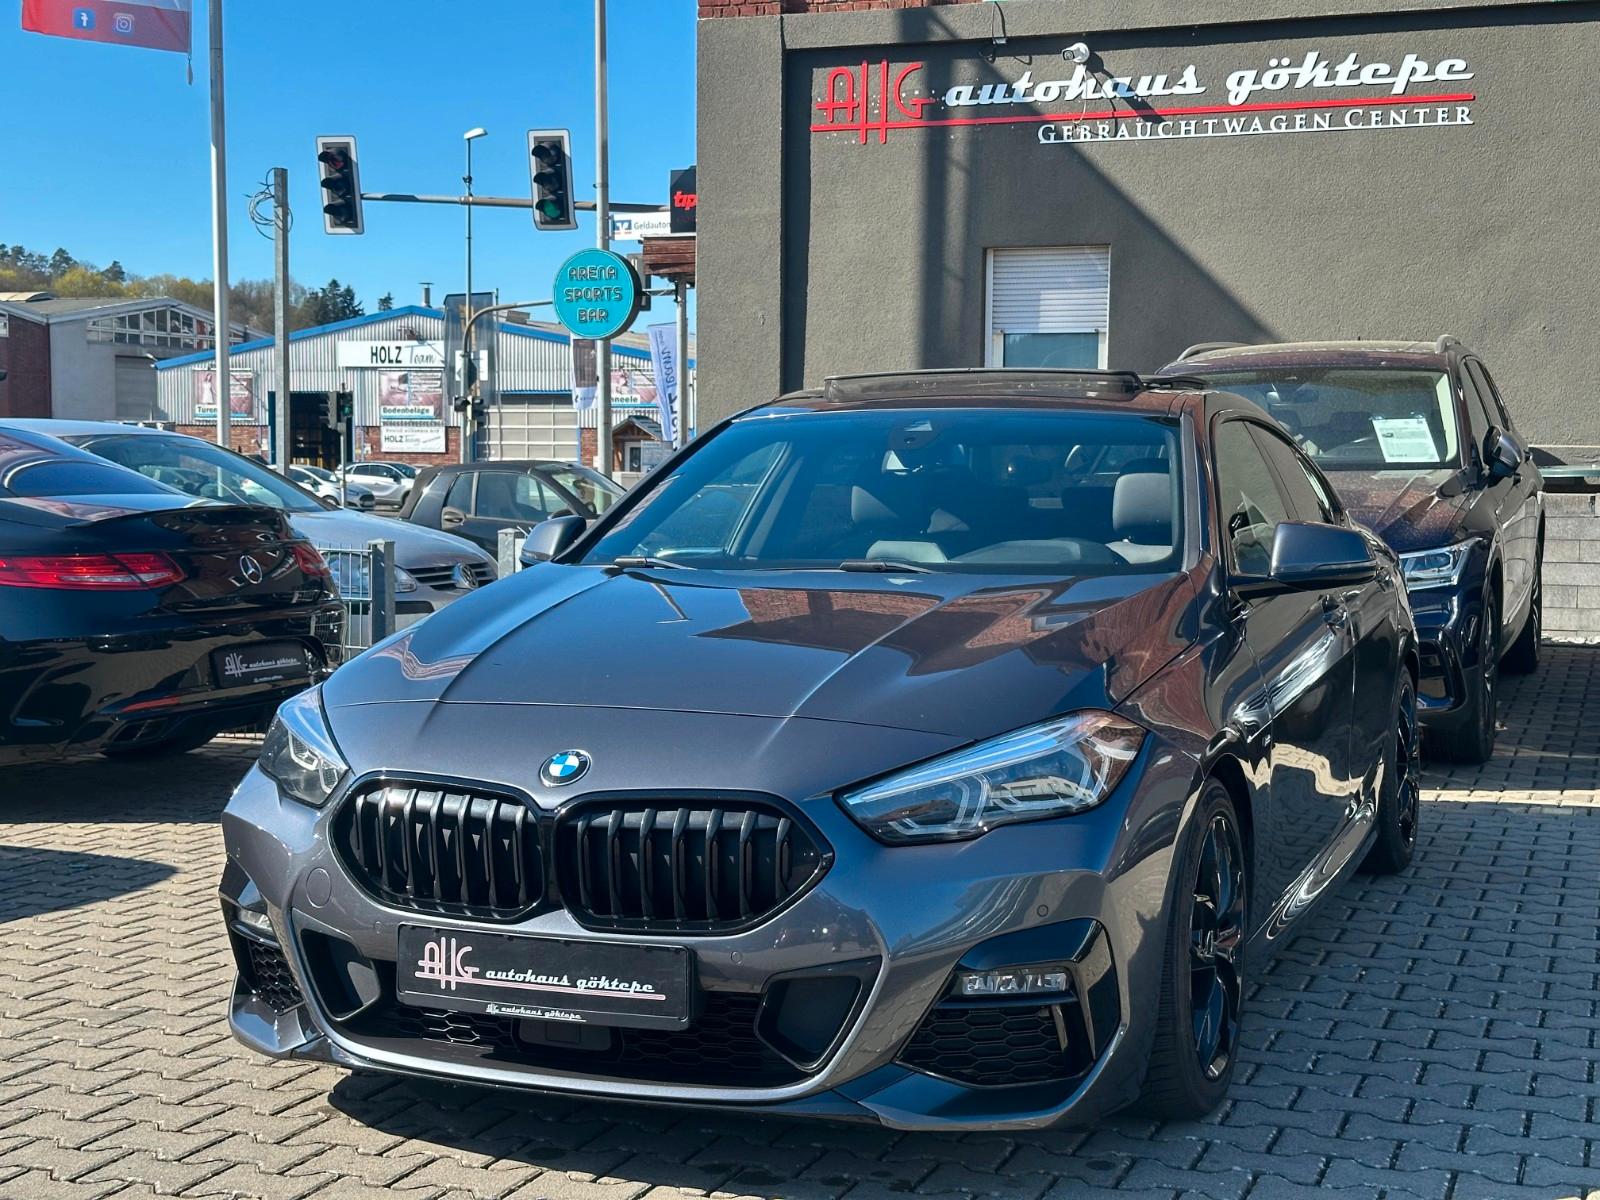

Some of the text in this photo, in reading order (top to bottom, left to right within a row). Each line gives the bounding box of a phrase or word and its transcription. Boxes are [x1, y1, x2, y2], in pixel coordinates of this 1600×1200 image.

[945, 65, 1207, 107] autohaus
[1225, 51, 1475, 106] göktepe
[568, 265, 618, 281] ARENA
[564, 286, 623, 303] SPORTS
[577, 308, 609, 324] BAR
[370, 346, 403, 365] HOLZ
[384, 435, 404, 443] HOLZ
[485, 967, 572, 988] autohaus
[576, 974, 656, 994] göktepe
[501, 1005, 543, 1018] autohaus
